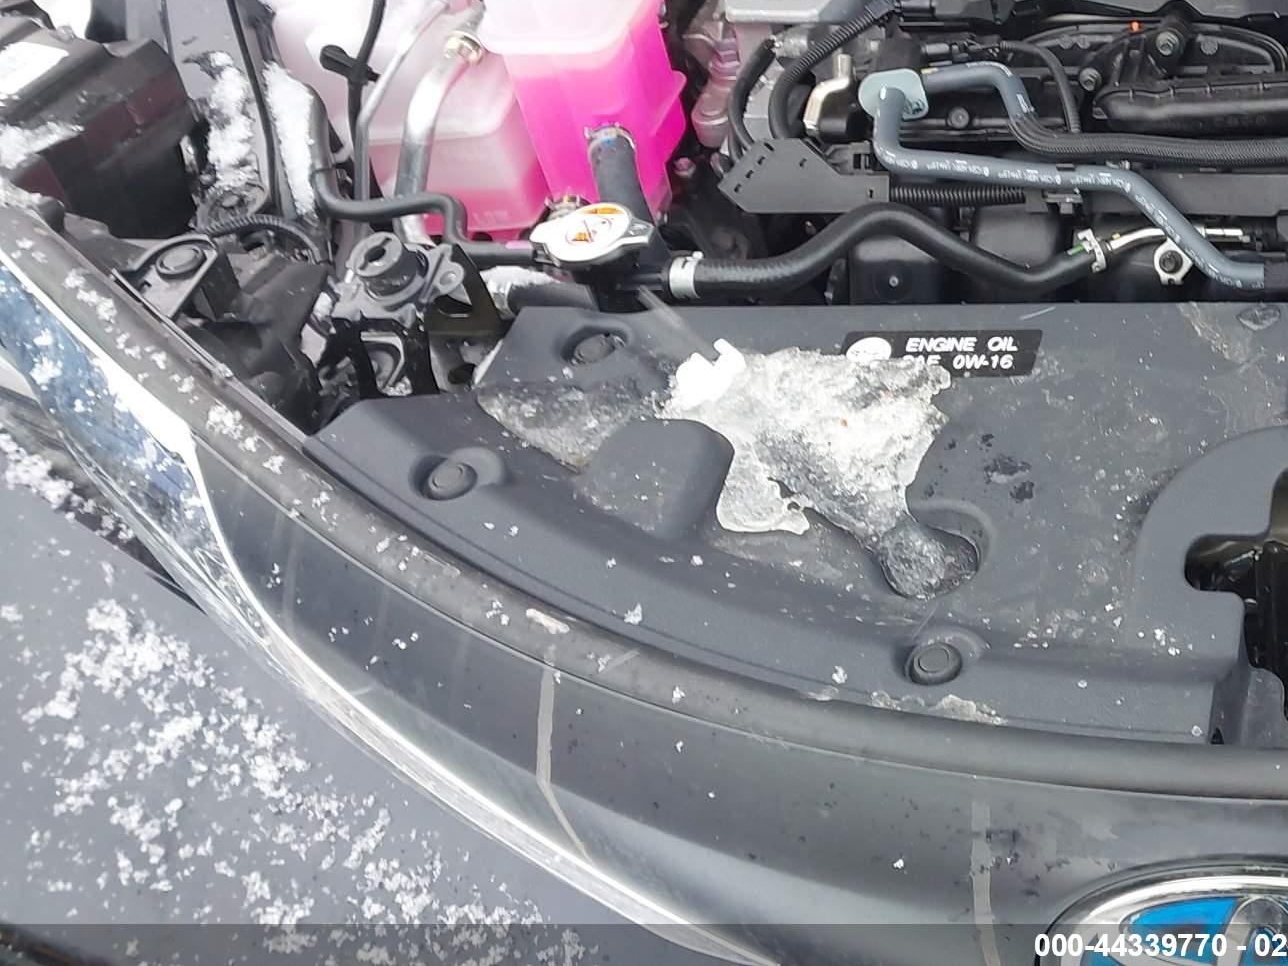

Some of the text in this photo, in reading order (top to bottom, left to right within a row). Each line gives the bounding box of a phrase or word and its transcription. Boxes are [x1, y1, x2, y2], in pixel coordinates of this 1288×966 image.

[905, 336, 1018, 352] ENGINE OIL
[952, 354, 1014, 369] 0W-16
